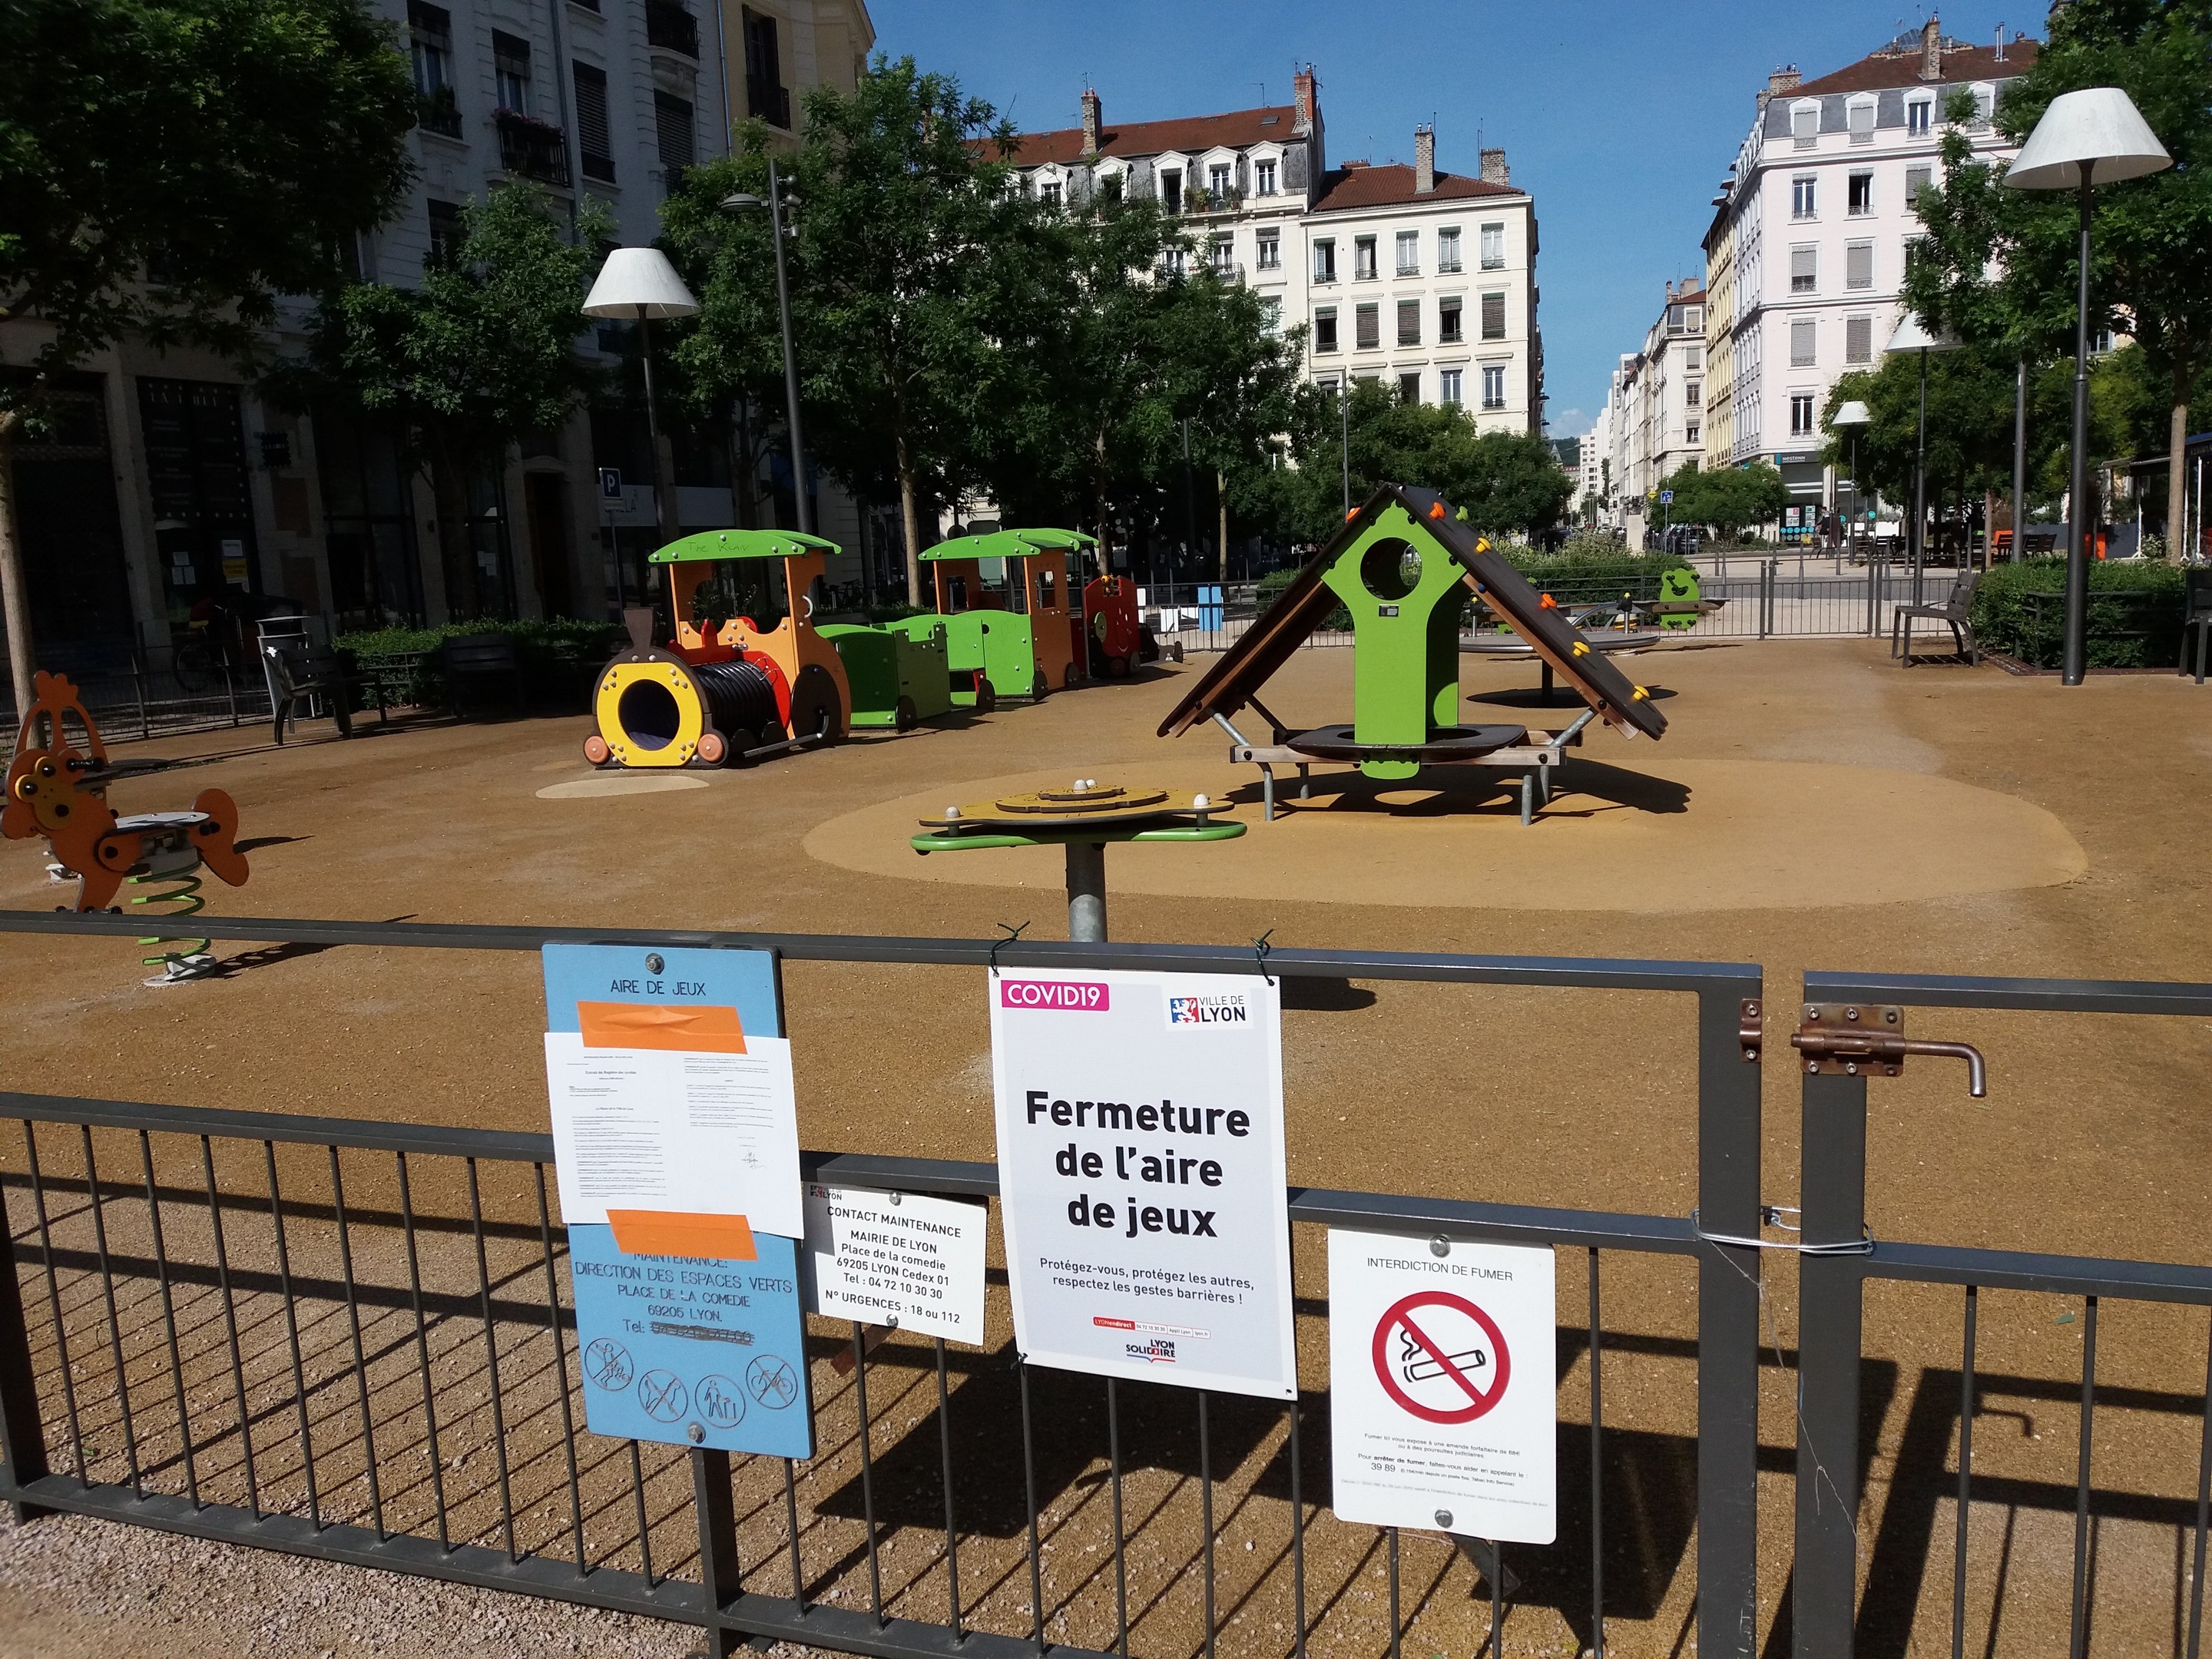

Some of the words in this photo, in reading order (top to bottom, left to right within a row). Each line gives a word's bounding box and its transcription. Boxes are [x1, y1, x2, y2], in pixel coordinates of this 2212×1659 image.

[607, 474, 616, 492] P
[688, 541, 710, 553] The
[611, 979, 640, 994] AIRE
[647, 980, 665, 995] DE
[672, 982, 706, 996] JEUX
[1007, 983, 1101, 1008] COVID19
[1199, 995, 1227, 1006] VILLE
[1230, 995, 1244, 1005] DE
[1200, 1006, 1246, 1023] LYON
[1026, 1091, 1250, 1137] Fermeture
[1056, 1143, 1103, 1178] de
[1116, 1146, 1223, 1187] l'aire
[823, 1191, 842, 1201] LYON
[828, 1206, 878, 1223] CONTACT
[881, 1214, 961, 1238] MAINTENANCE
[1068, 1194, 1115, 1228] de
[1126, 1197, 1217, 1238] jeux
[851, 1230, 889, 1245] MAIRIE
[892, 1237, 906, 1248] DE
[909, 1240, 937, 1254] LYON
[842, 1243, 870, 1257] Place
[873, 1249, 886, 1260] de
[889, 1250, 899, 1261] la
[902, 1256, 945, 1270] comedie
[575, 1261, 641, 1280] DIRECTION
[647, 1268, 674, 1283] DES
[680, 1271, 742, 1289] ESPACES
[748, 1277, 793, 1293] VERTS
[836, 1257, 868, 1270] 69205
[872, 1263, 899, 1277] LYON
[902, 1268, 934, 1283] Cedex
[937, 1275, 949, 1286] 01
[1040, 1258, 1129, 1278] Protégez-vous,
[1132, 1269, 1185, 1283] protégez
[1189, 1272, 1207, 1284] les
[1210, 1277, 1253, 1291] autres,
[1367, 1257, 1449, 1273] INTERDICTION
[1452, 1264, 1468, 1276] DE
[1472, 1267, 1513, 1281] FUMER
[618, 1284, 655, 1299] PLACE
[661, 1288, 676, 1300] DE
[680, 1290, 697, 1302] LA
[702, 1292, 751, 1307] COMEDIE
[843, 1272, 859, 1284] Tel
[869, 1277, 881, 1287] 04
[884, 1280, 896, 1290] 72
[900, 1283, 912, 1293] 10
[915, 1285, 927, 1296] 30
[930, 1288, 942, 1300] 30
[1053, 1277, 1110, 1290] respectez
[1113, 1280, 1131, 1293] les
[1134, 1285, 1174, 1297] gestes
[1177, 1287, 1235, 1303] barrières
[1239, 1293, 1242, 1304] !
[648, 1304, 684, 1318] 69205
[826, 1290, 839, 1300] N°
[842, 1293, 901, 1311] URGENCES
[911, 1305, 922, 1316] 18
[926, 1310, 938, 1320] ou
[942, 1311, 960, 1324] 112
[623, 1318, 645, 1333] Tel:
[1094, 1318, 1132, 1329] LYONendirect
[1151, 1339, 1175, 1349] LYON
[1371, 1462, 1382, 1471] 39
[1384, 1464, 1396, 1472] 89
